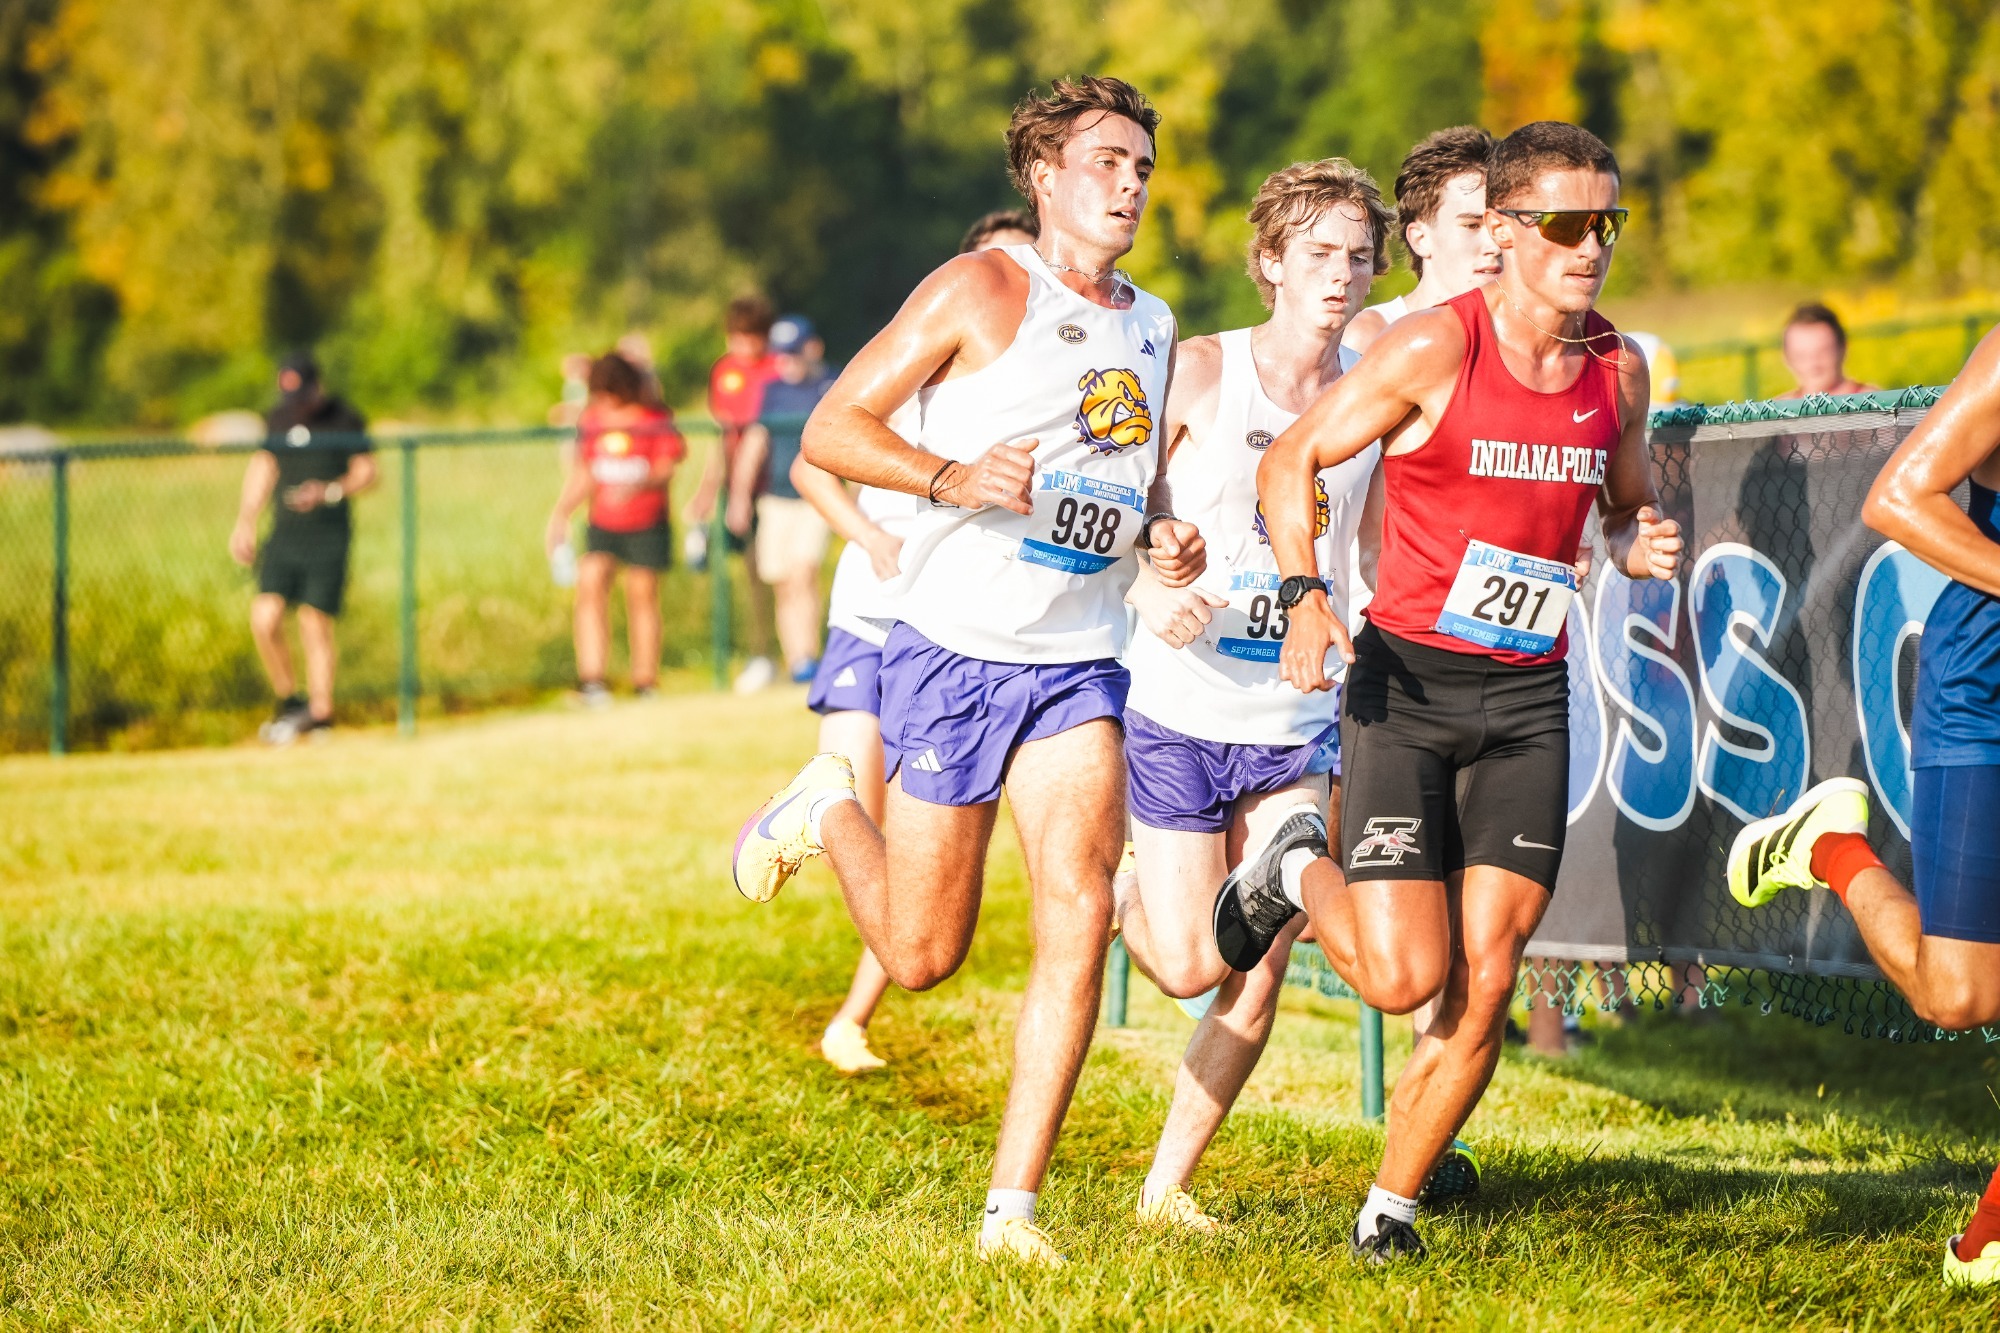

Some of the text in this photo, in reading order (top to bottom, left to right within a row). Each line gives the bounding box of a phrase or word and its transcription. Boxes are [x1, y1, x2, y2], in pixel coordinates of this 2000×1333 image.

[1251, 436, 1270, 446] OVC
[1469, 439, 1608, 485] INDIANAPOLIS
[1084, 479, 1100, 489] JOHN
[1052, 497, 1121, 554] 938
[1032, 549, 1076, 567] SEPTEMBER
[1514, 558, 1533, 569] JOHN
[1472, 575, 1550, 630] 291
[1247, 594, 1290, 640] 93
[1452, 622, 1501, 643] SEPTEMBER
[1516, 638, 1539, 650] 2026
[1231, 645, 1276, 657] SEPTEMBER
